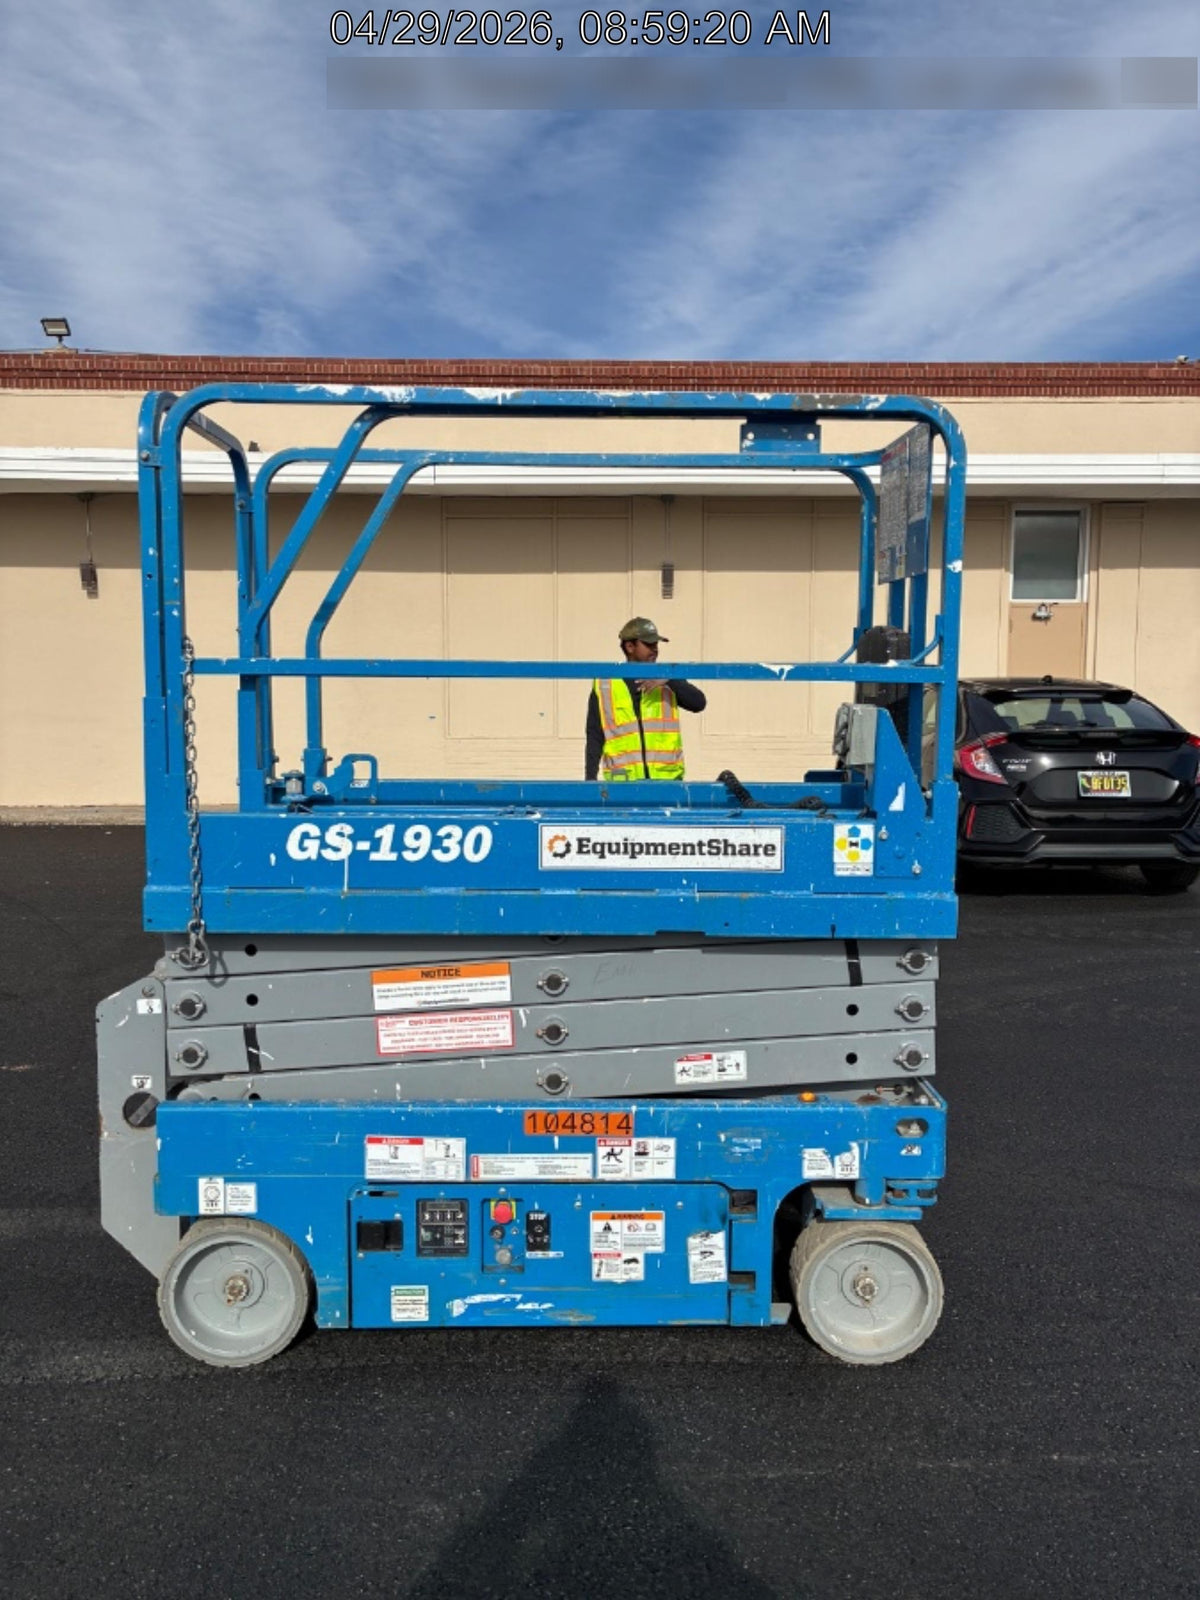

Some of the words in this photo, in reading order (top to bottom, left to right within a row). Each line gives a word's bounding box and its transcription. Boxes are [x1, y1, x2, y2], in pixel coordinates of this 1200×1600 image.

[285, 823, 493, 863] GS-1930
[576, 837, 776, 860] EquipmentShare
[420, 967, 461, 979] NOTICE
[527, 1112, 632, 1135] 104814
